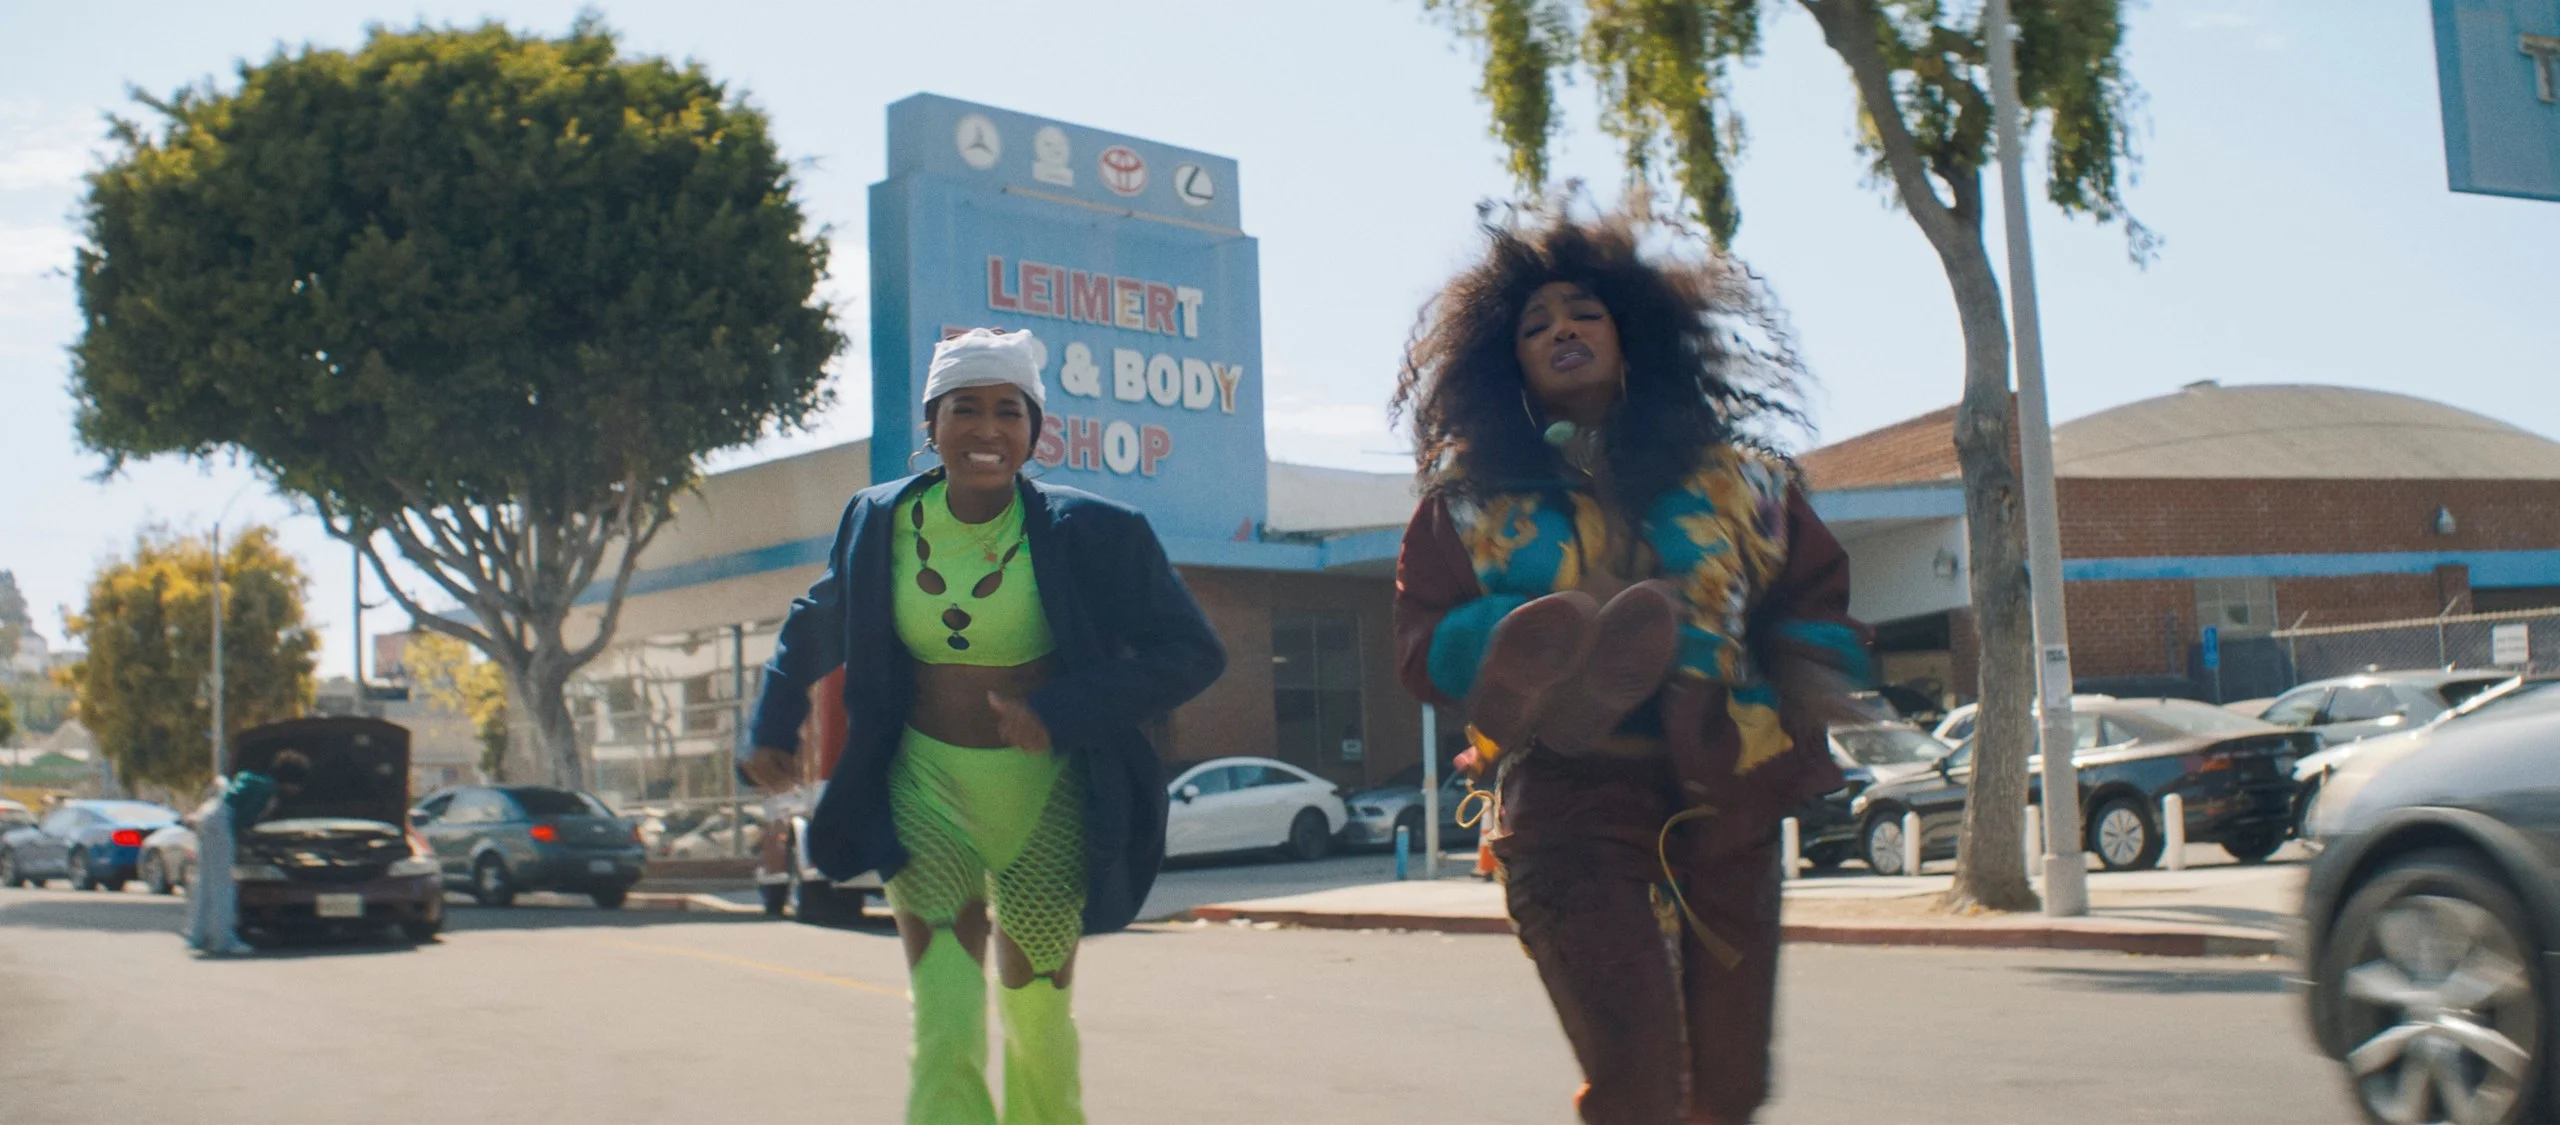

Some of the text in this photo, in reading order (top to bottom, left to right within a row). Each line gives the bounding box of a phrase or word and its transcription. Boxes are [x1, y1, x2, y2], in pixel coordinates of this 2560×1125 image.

[988, 257, 1203, 338] LEIMERT
[1061, 342, 1099, 397] &
[1115, 348, 1242, 413] BODY
[1034, 415, 1171, 475] SHOP
